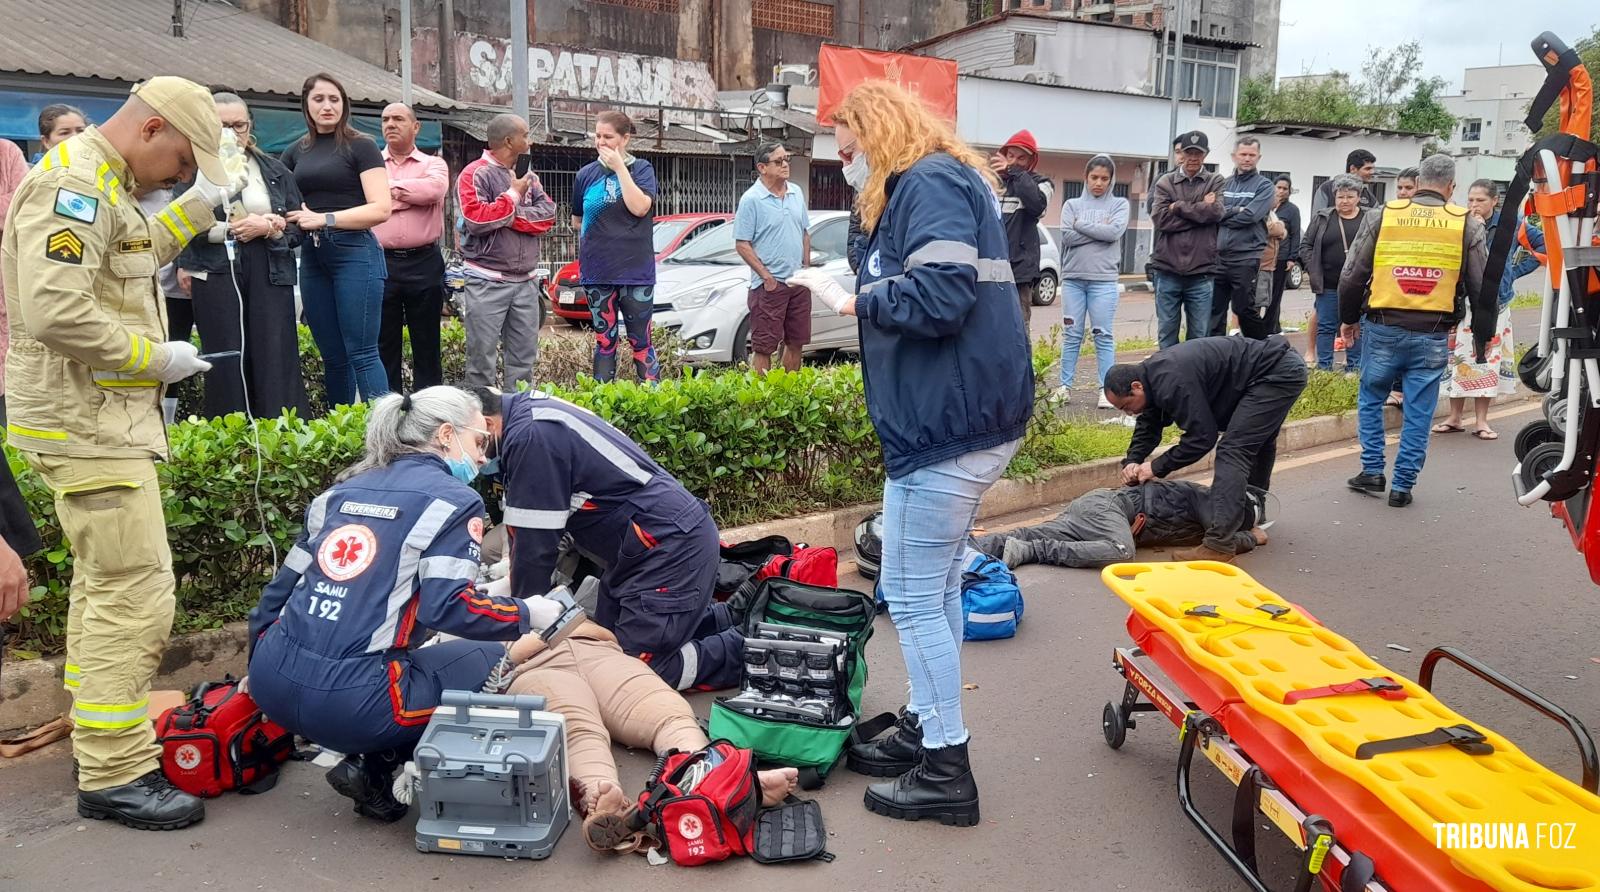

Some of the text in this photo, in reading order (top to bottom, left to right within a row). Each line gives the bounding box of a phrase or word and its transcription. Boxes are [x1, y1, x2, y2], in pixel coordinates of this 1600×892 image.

[1397, 218, 1448, 228] MOTO TAXI
[1393, 267, 1442, 278] CASA BO
[343, 503, 396, 517] ENFERMEIRA
[314, 581, 348, 598] SAMU
[308, 596, 342, 621] 192
[1134, 672, 1156, 699] FORZA
[687, 839, 704, 847] SAMU
[687, 845, 705, 857] 192
